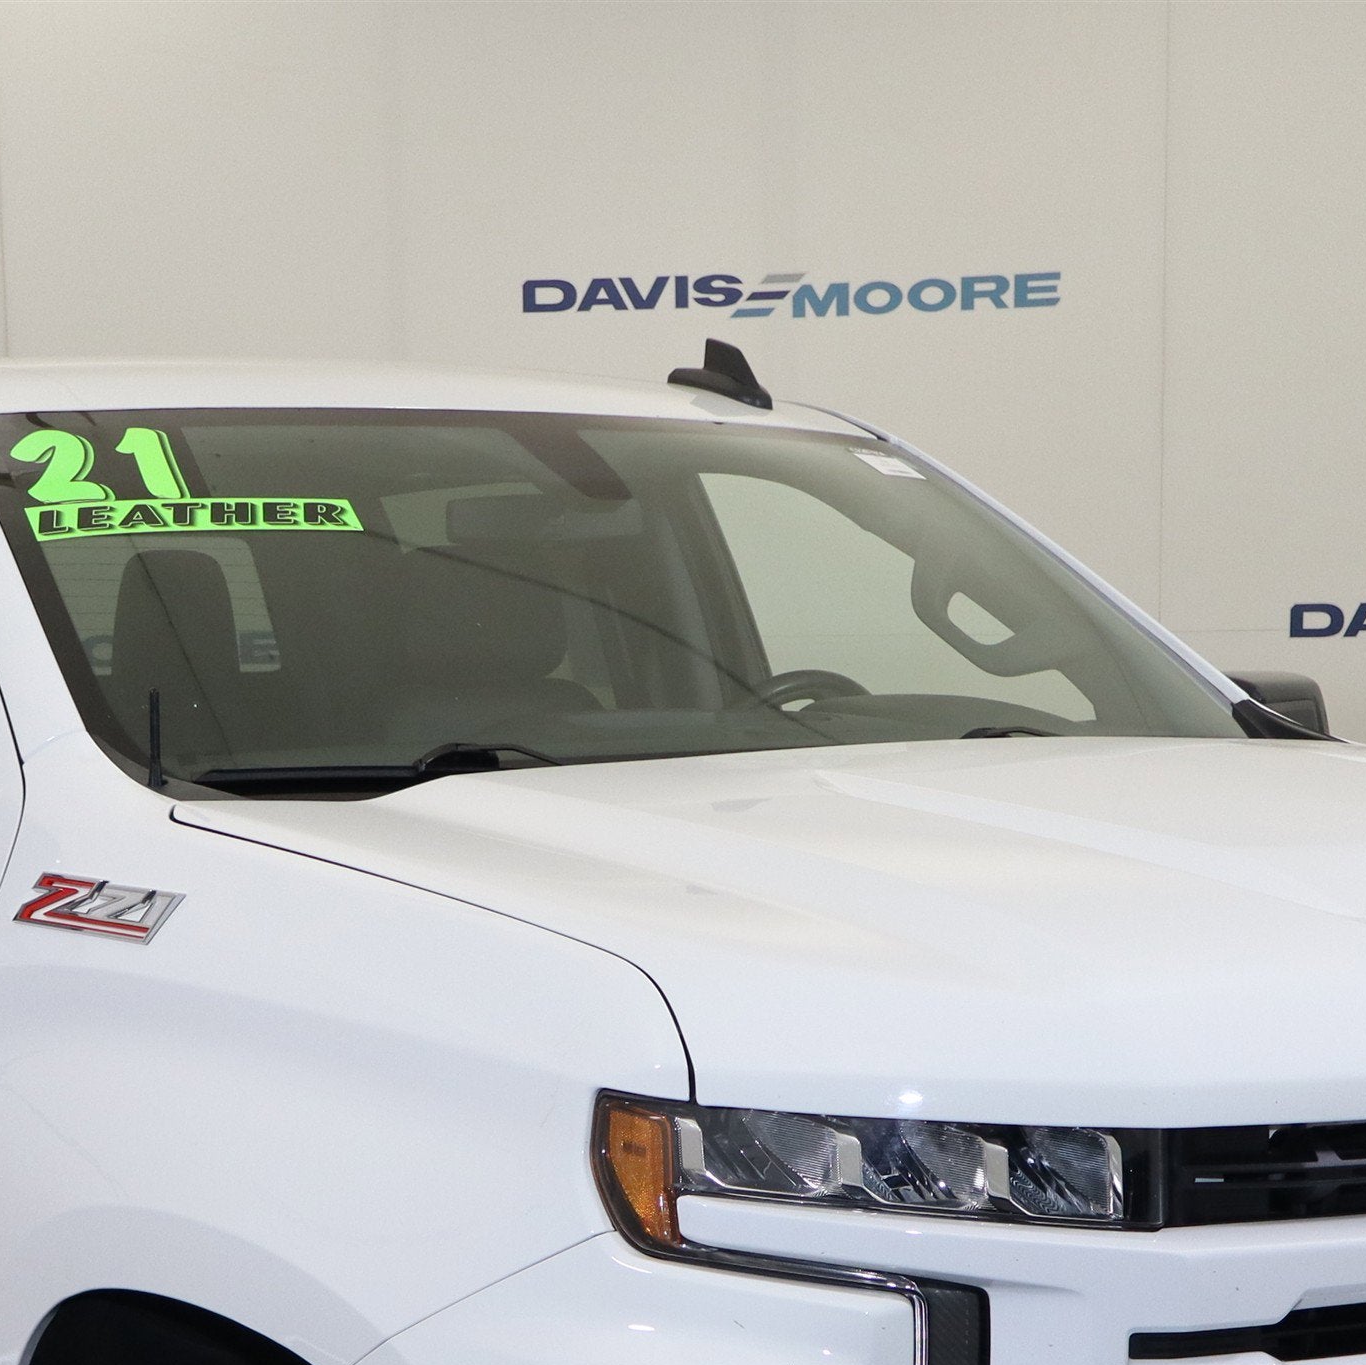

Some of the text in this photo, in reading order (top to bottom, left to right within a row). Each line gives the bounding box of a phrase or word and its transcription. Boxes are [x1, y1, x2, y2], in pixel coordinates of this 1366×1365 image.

[521, 271, 1061, 319] DAVIS MOORE
[10, 427, 190, 503] 21
[37, 501, 349, 536] LEATHER
[13, 872, 186, 945] Z71
